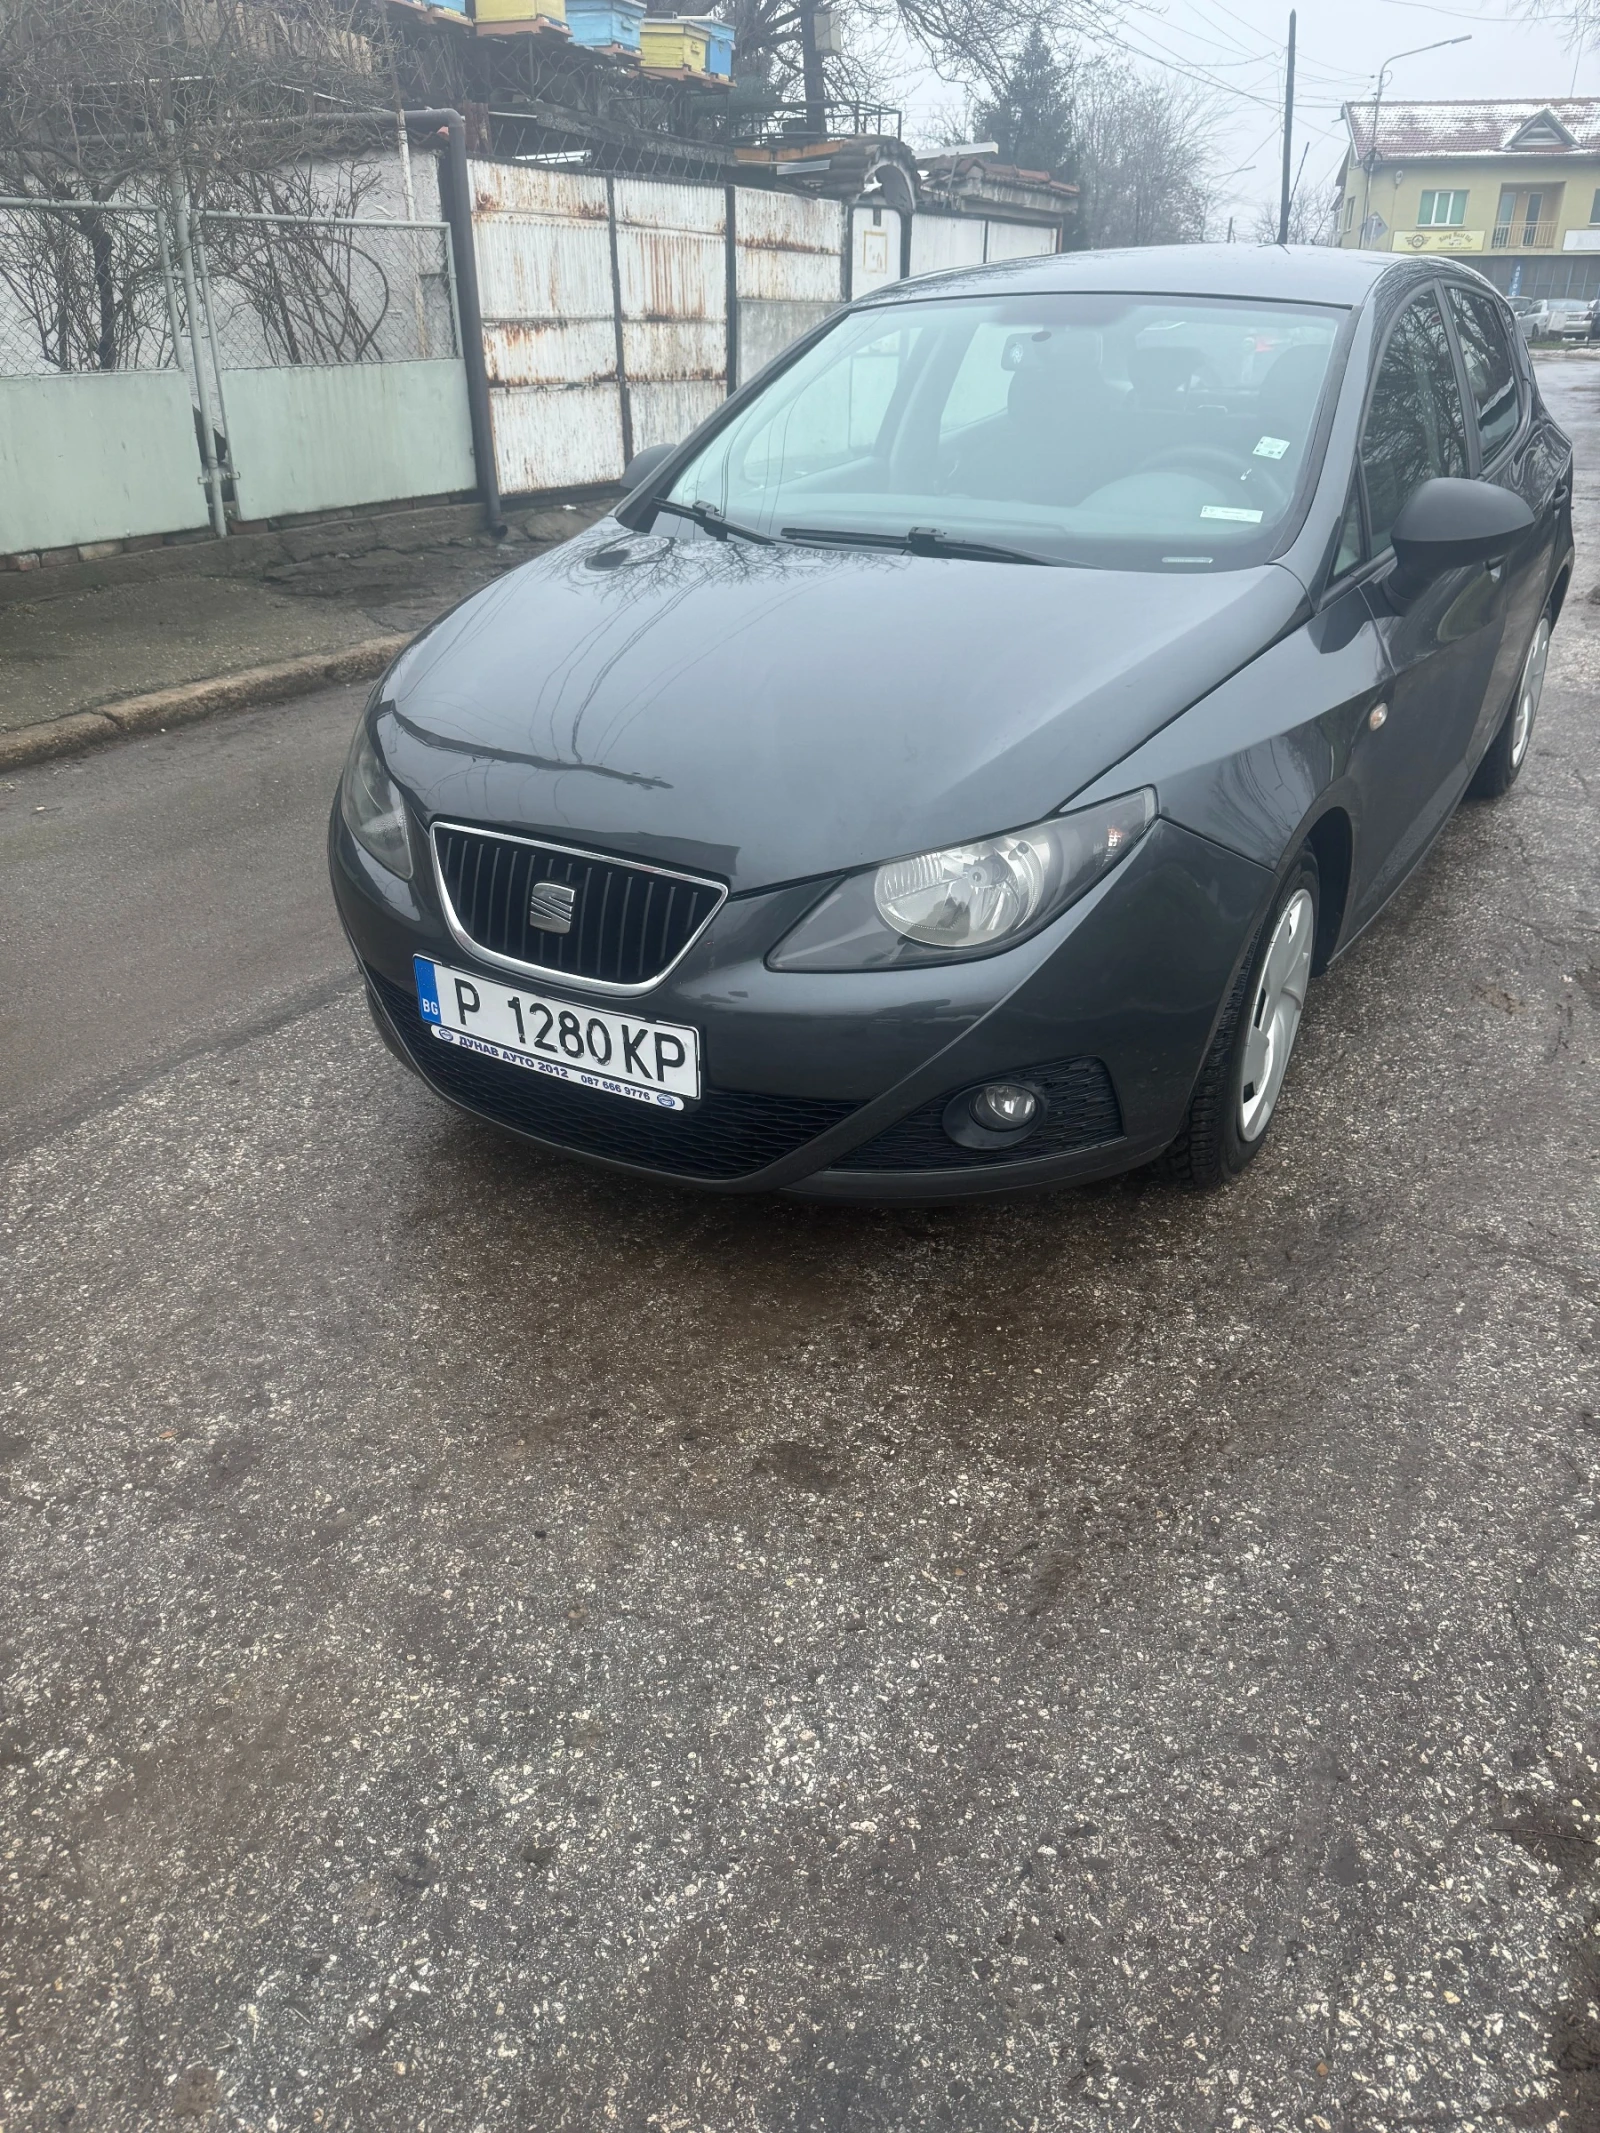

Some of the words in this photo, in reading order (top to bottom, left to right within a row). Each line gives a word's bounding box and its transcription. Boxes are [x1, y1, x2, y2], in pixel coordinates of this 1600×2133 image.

[422, 998, 439, 1016] BG
[459, 1036, 499, 1057] ДУНАВ
[502, 1051, 535, 1068] АУТО
[538, 1061, 569, 1078] 2012
[581, 1075, 599, 1086] 087
[602, 1081, 622, 1093] 666
[624, 1087, 650, 1101] 9776
